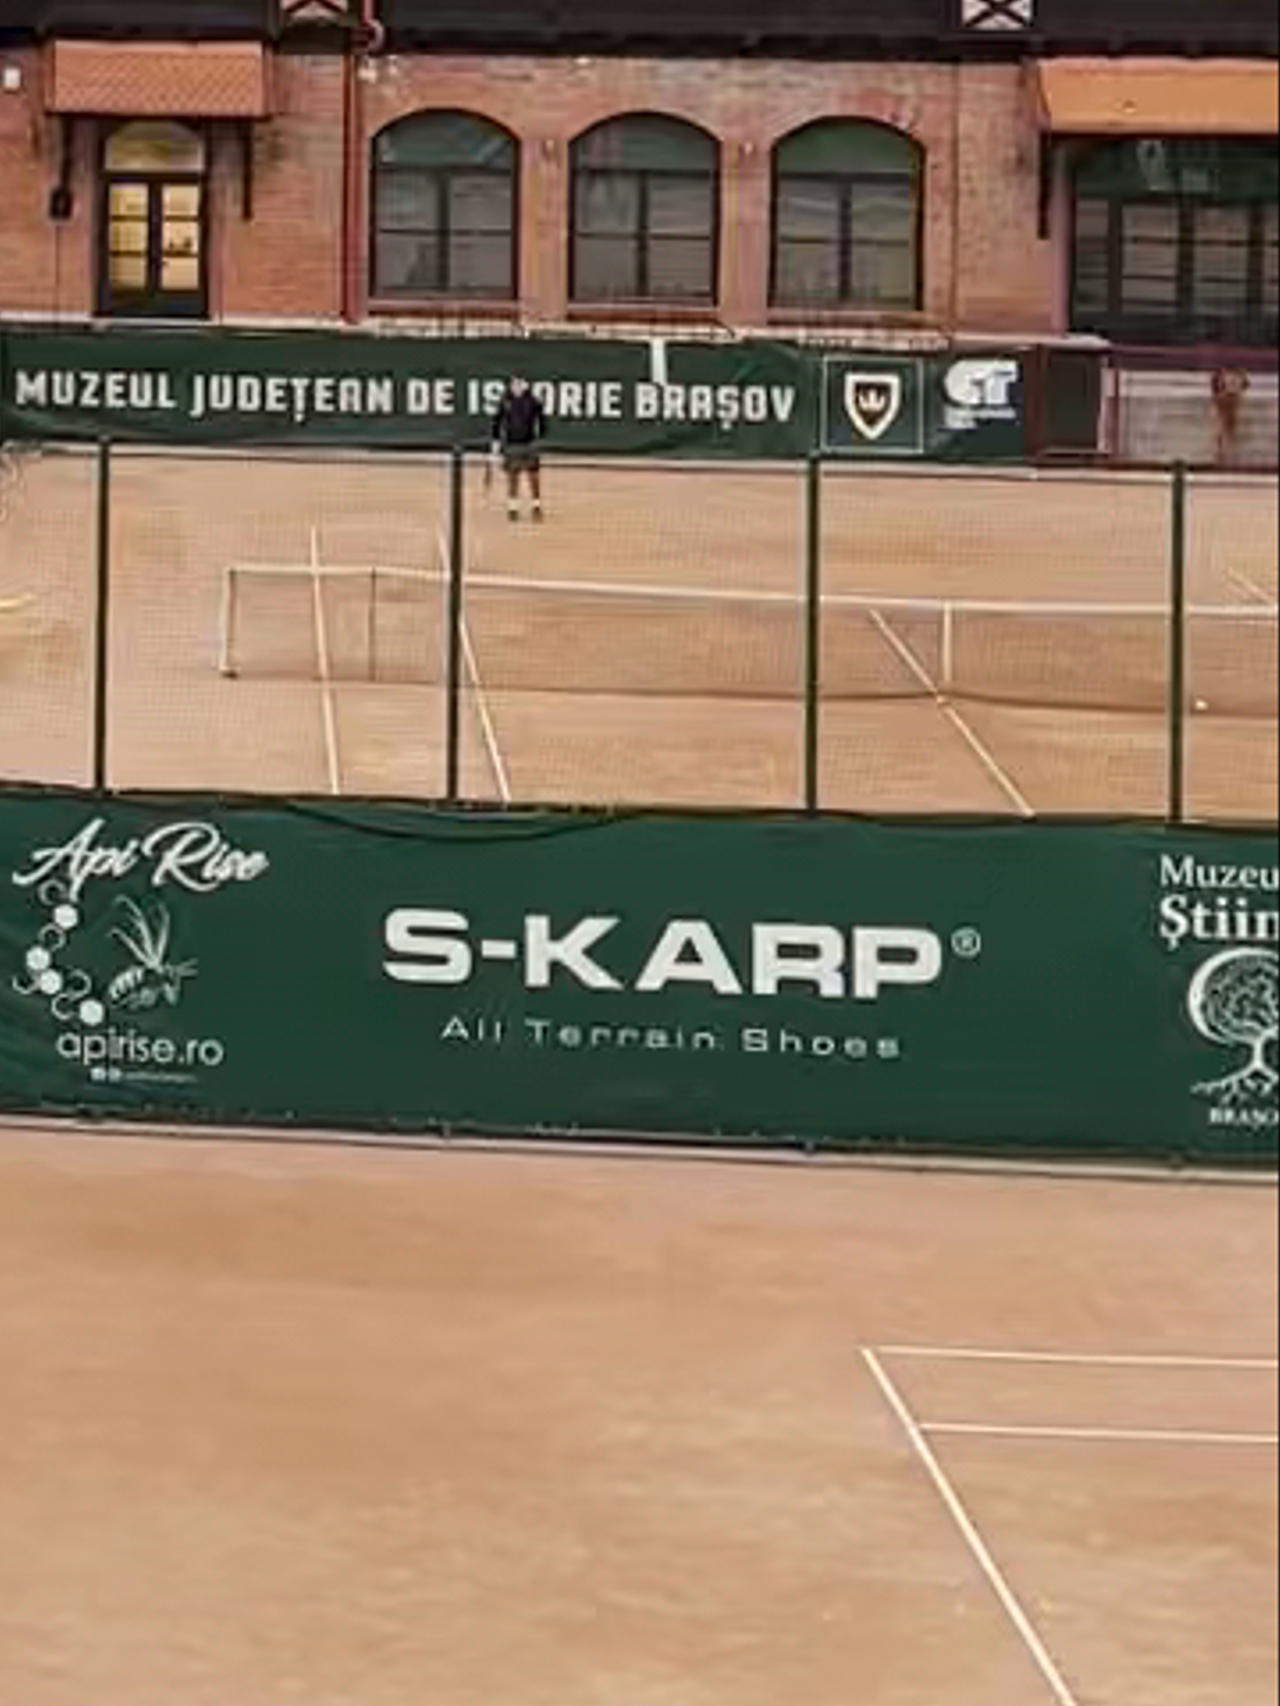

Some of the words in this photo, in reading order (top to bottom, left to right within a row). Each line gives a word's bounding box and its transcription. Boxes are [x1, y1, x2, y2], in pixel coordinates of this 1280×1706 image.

[15, 370, 177, 410] MUZEUL
[190, 373, 394, 424] JUDEȚEAN
[406, 377, 455, 415] DE
[467, 379, 623, 418] ISORIE
[635, 383, 796, 431] BRAȘOV
[12, 818, 139, 902] Api
[141, 822, 270, 892] Rise
[55, 1026, 225, 1067] apirise.ro
[440, 1016, 503, 1044] All
[525, 1018, 717, 1050] Terrain
[742, 1027, 901, 1059] Shoes
